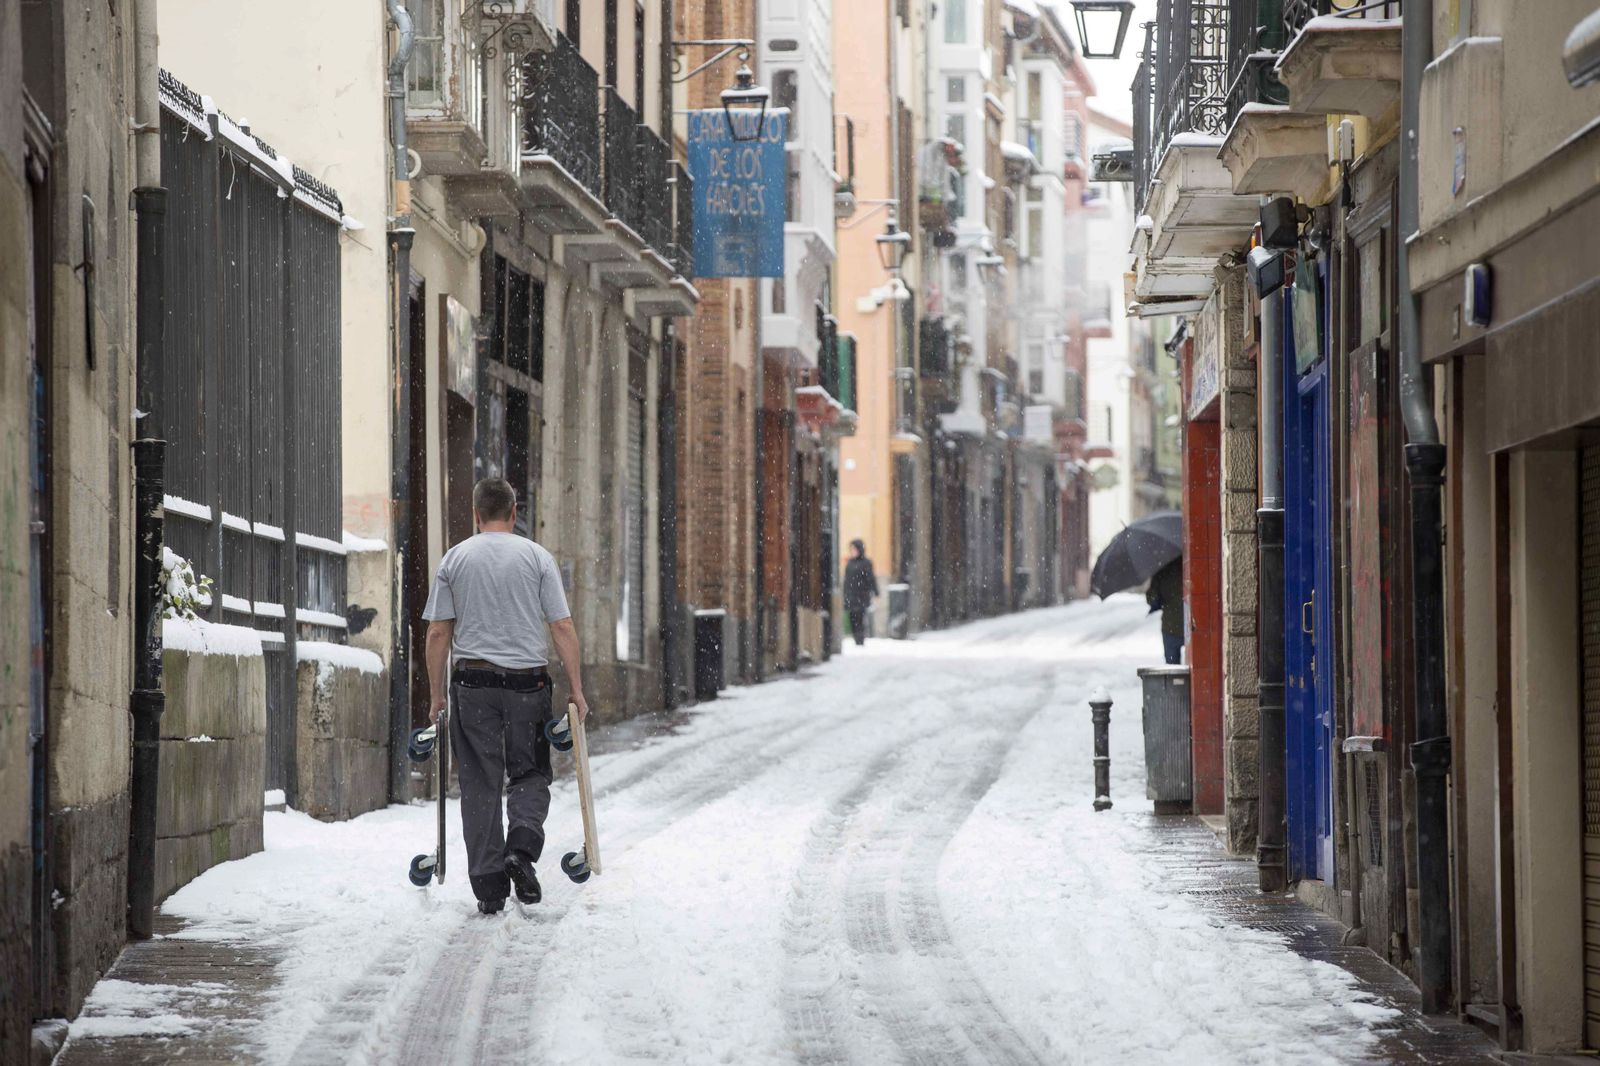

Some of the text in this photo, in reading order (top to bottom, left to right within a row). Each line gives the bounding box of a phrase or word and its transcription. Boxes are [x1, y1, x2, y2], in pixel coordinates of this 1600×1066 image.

[689, 111, 726, 143] CASA
[709, 146, 763, 178] DE LOS
[706, 182, 766, 215] FAROLES
